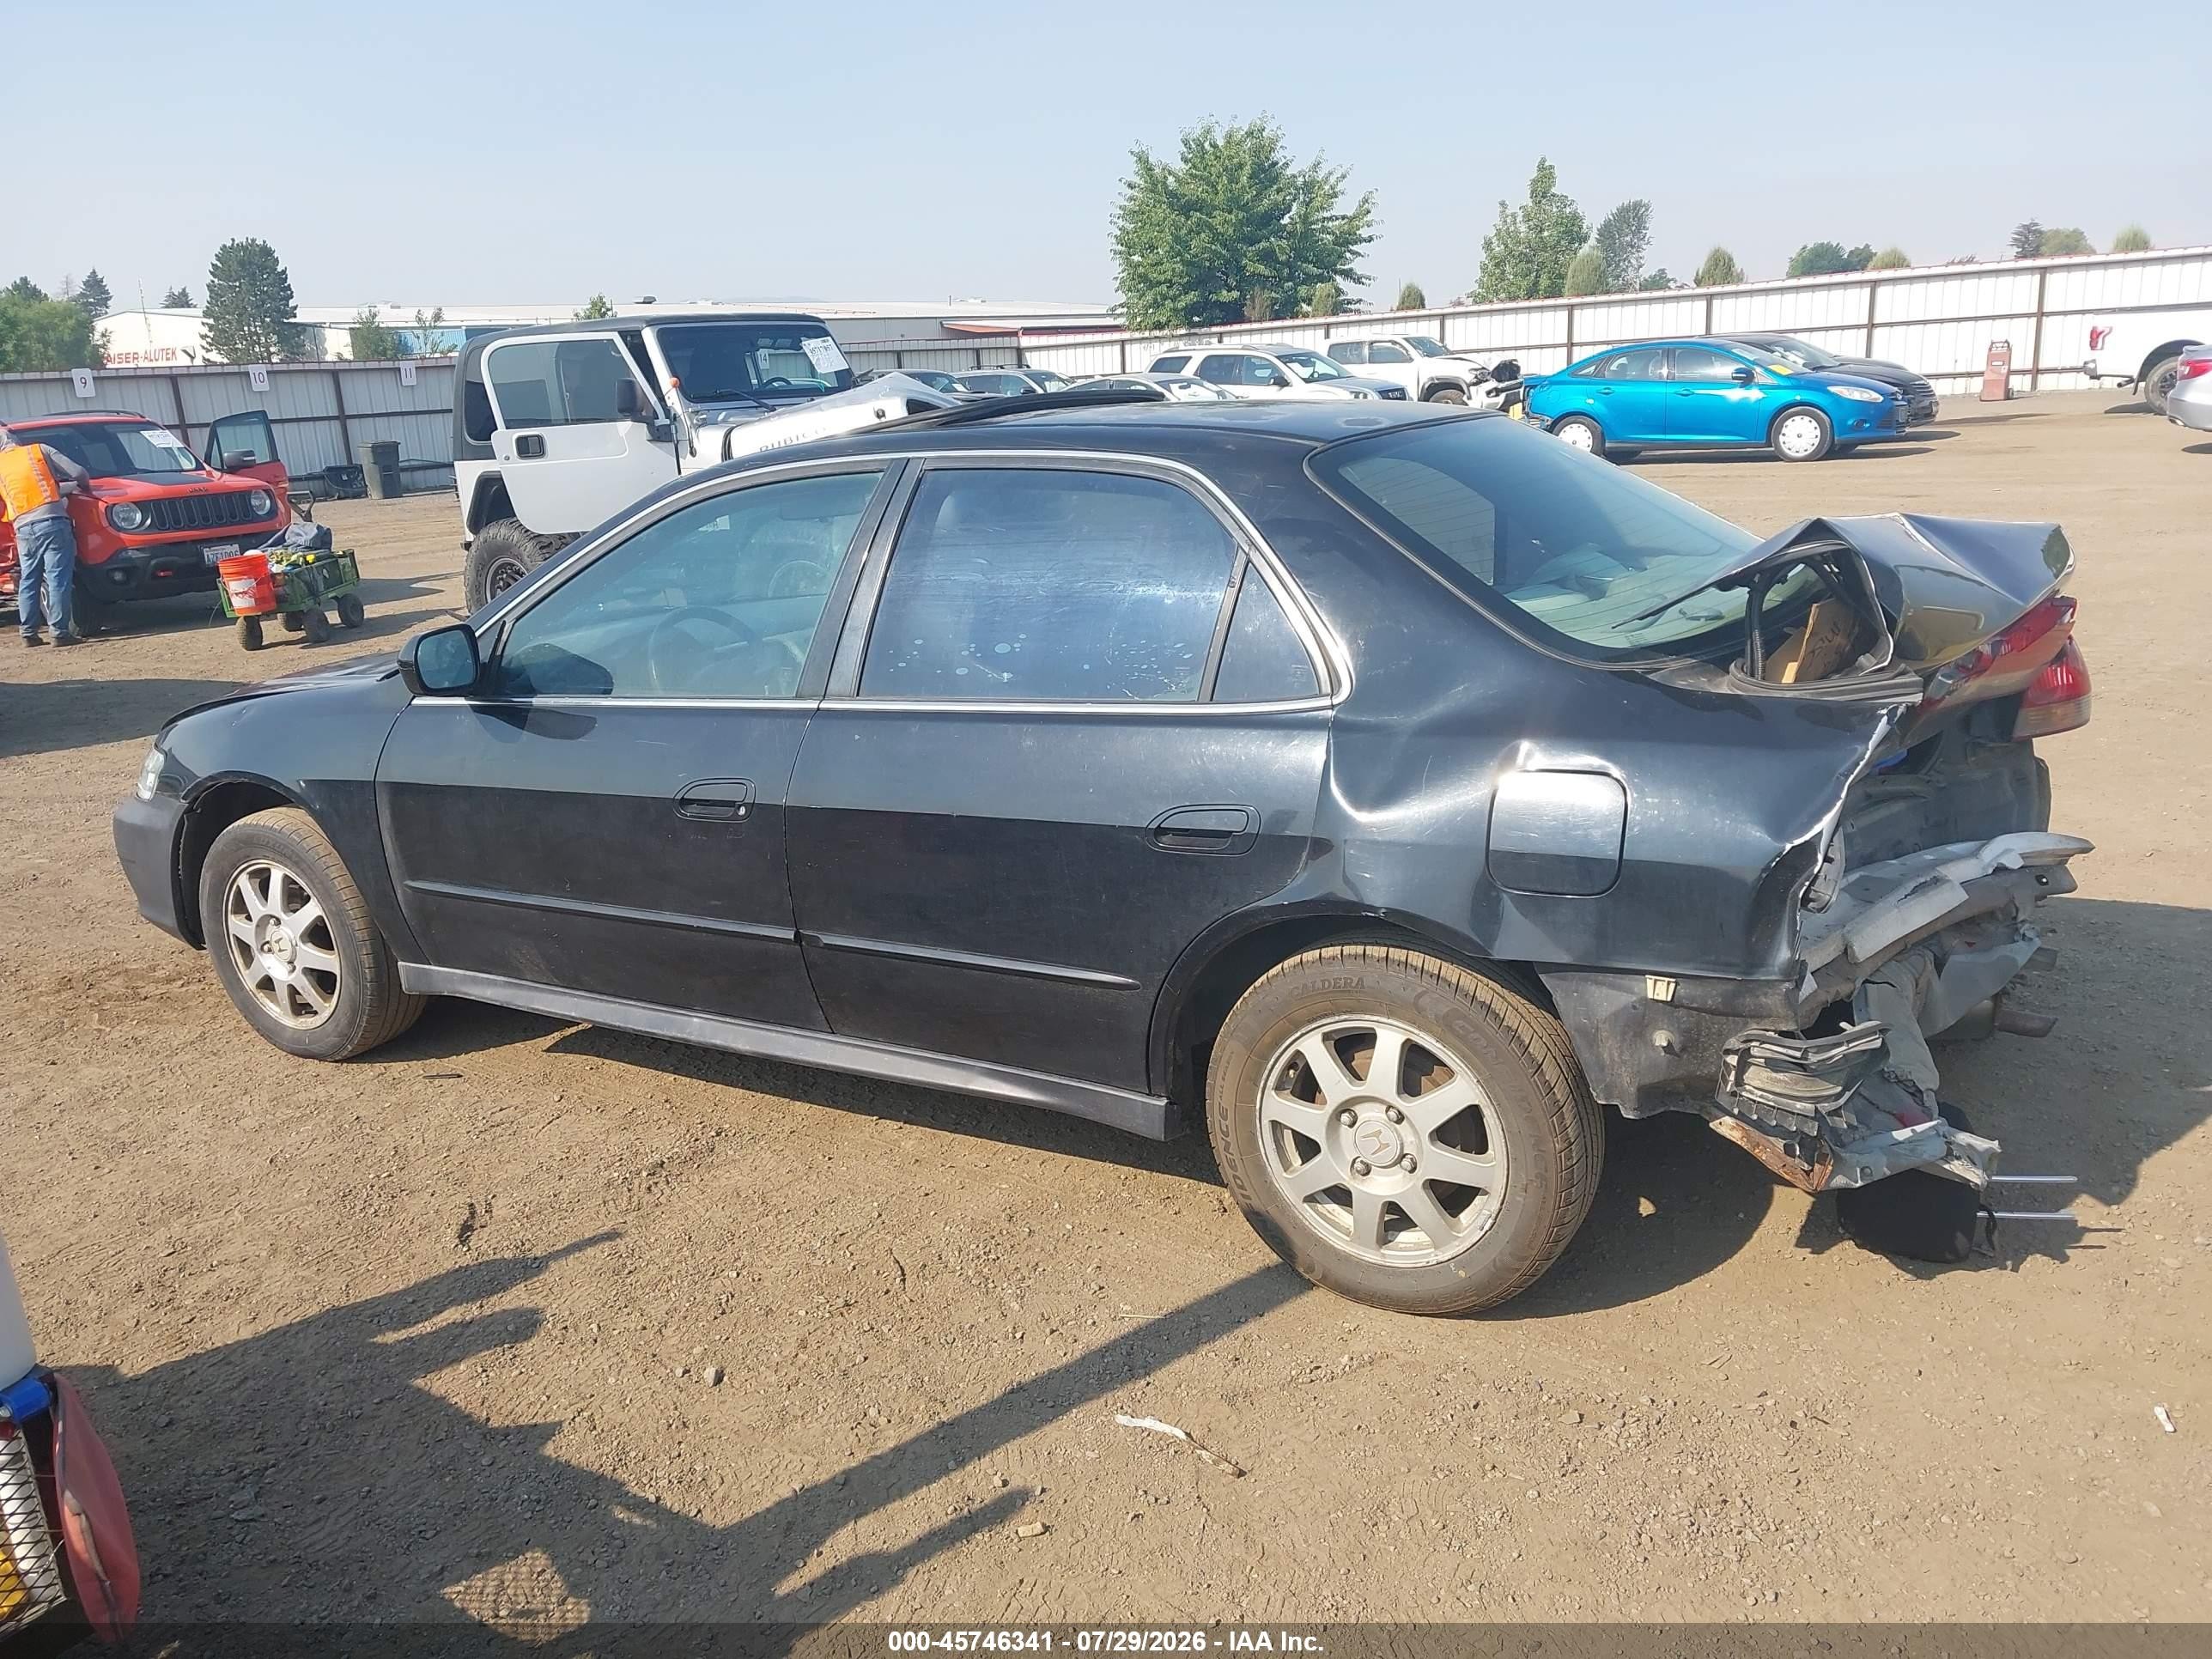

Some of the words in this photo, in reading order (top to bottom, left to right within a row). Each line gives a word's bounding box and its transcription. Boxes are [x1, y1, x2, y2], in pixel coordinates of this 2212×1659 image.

[105, 347, 177, 365] AISER-ALUTEK
[252, 372, 265, 384] 10
[404, 368, 412, 379] 11
[80, 376, 87, 389] 9
[1290, 976, 1367, 998] CALDERA
